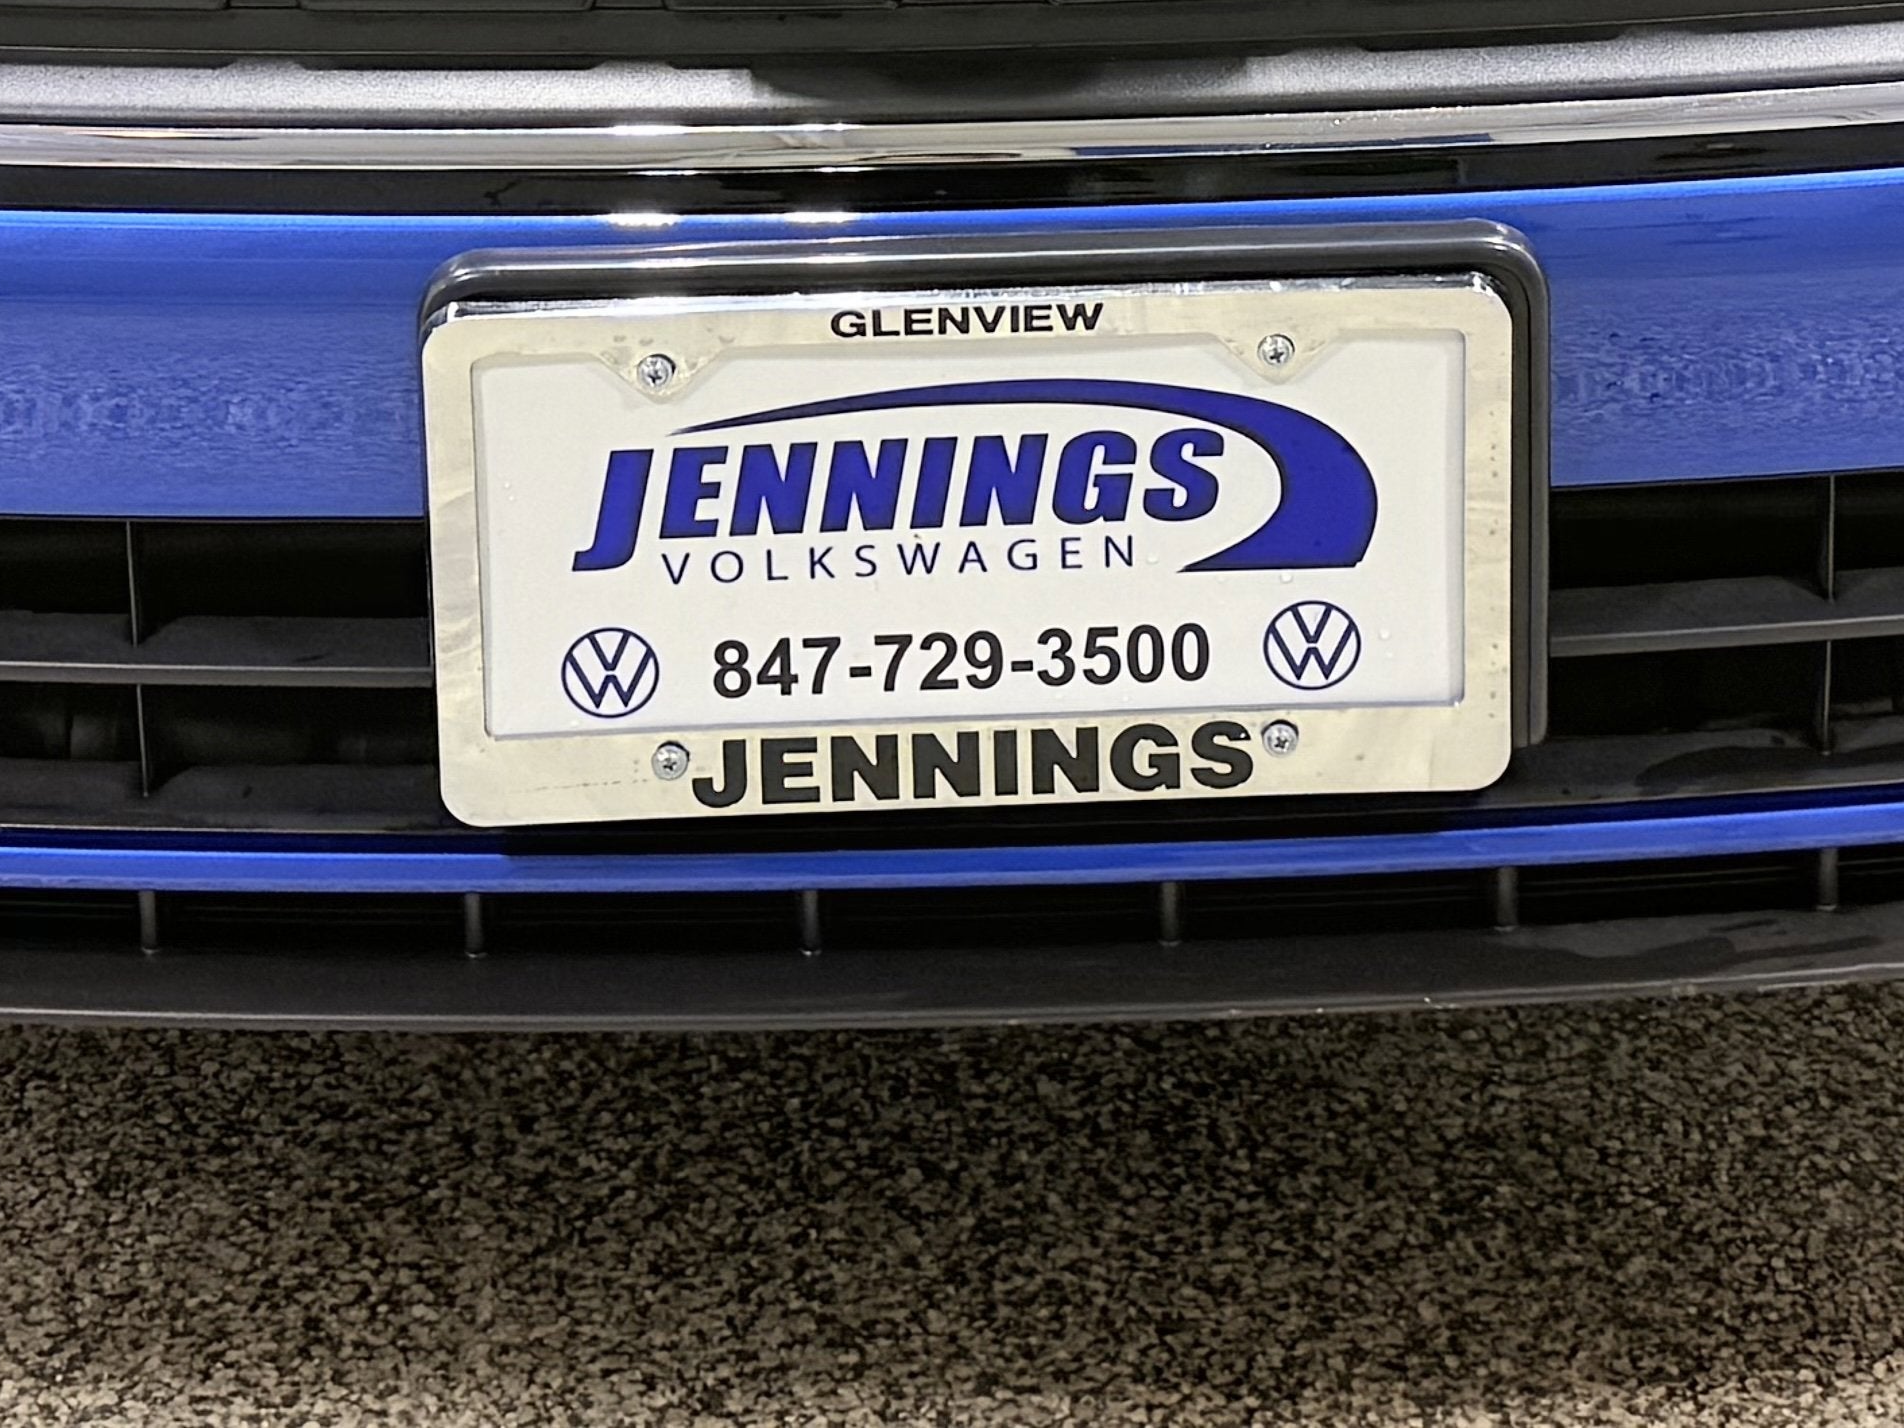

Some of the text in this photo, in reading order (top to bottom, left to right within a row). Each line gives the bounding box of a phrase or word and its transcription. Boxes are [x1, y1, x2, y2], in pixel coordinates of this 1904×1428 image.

[829, 301, 1105, 339] GLENVIEW
[570, 426, 1226, 573] JENNINGS
[660, 534, 1134, 586] VOLKSWAGEN
[712, 621, 1211, 700] 847-729-3500
[690, 719, 1255, 810] JENNINGS
